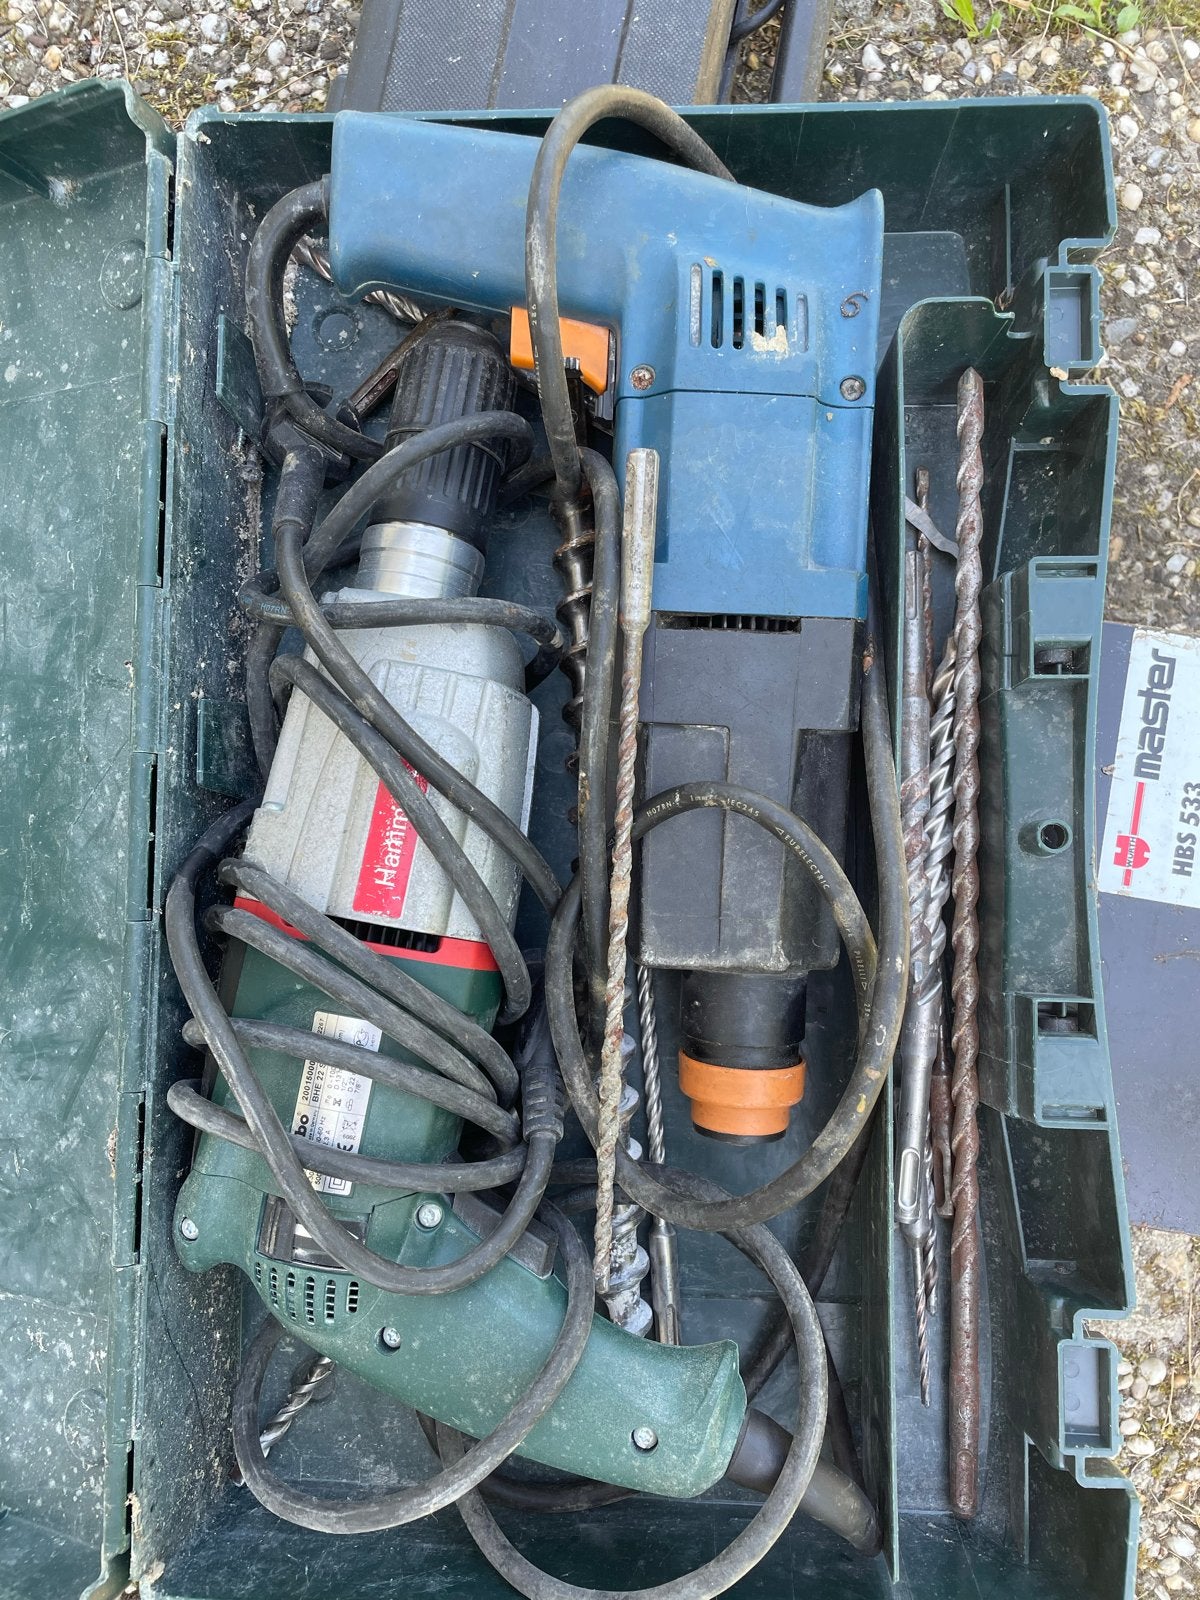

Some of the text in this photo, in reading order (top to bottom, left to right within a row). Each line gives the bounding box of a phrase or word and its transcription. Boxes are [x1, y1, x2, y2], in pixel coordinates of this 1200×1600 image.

[1133, 648, 1177, 781] master
[374, 807, 409, 887] Hamm
[1171, 781, 1200, 878] HBS 533
[312, 1083, 322, 1102] BHE
[316, 1070, 325, 1081] 22
